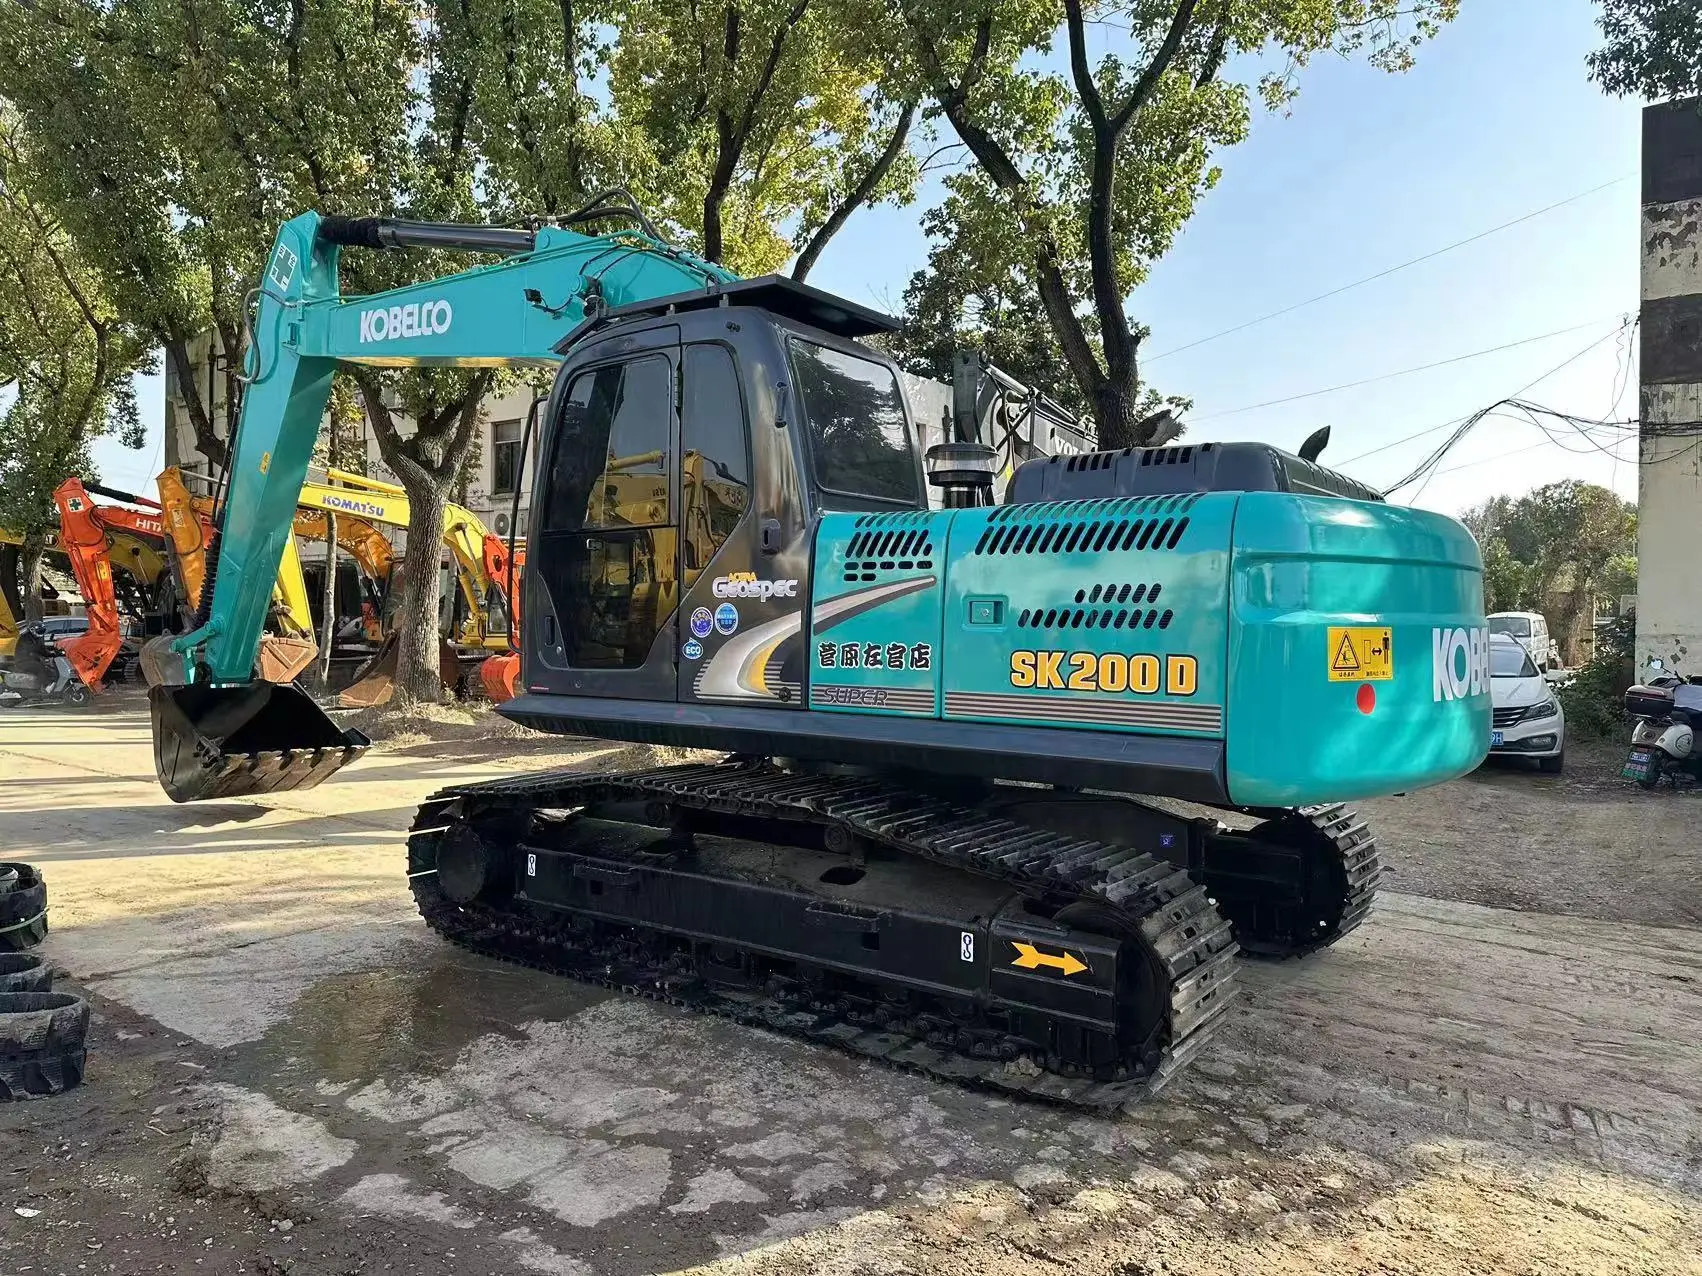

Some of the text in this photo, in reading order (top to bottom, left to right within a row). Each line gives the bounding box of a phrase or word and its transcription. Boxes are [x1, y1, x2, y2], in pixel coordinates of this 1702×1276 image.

[360, 299, 453, 343] KOBELCO
[322, 495, 384, 516] KOMATSU
[686, 646, 701, 655] ECO
[824, 687, 888, 706] SUPER
